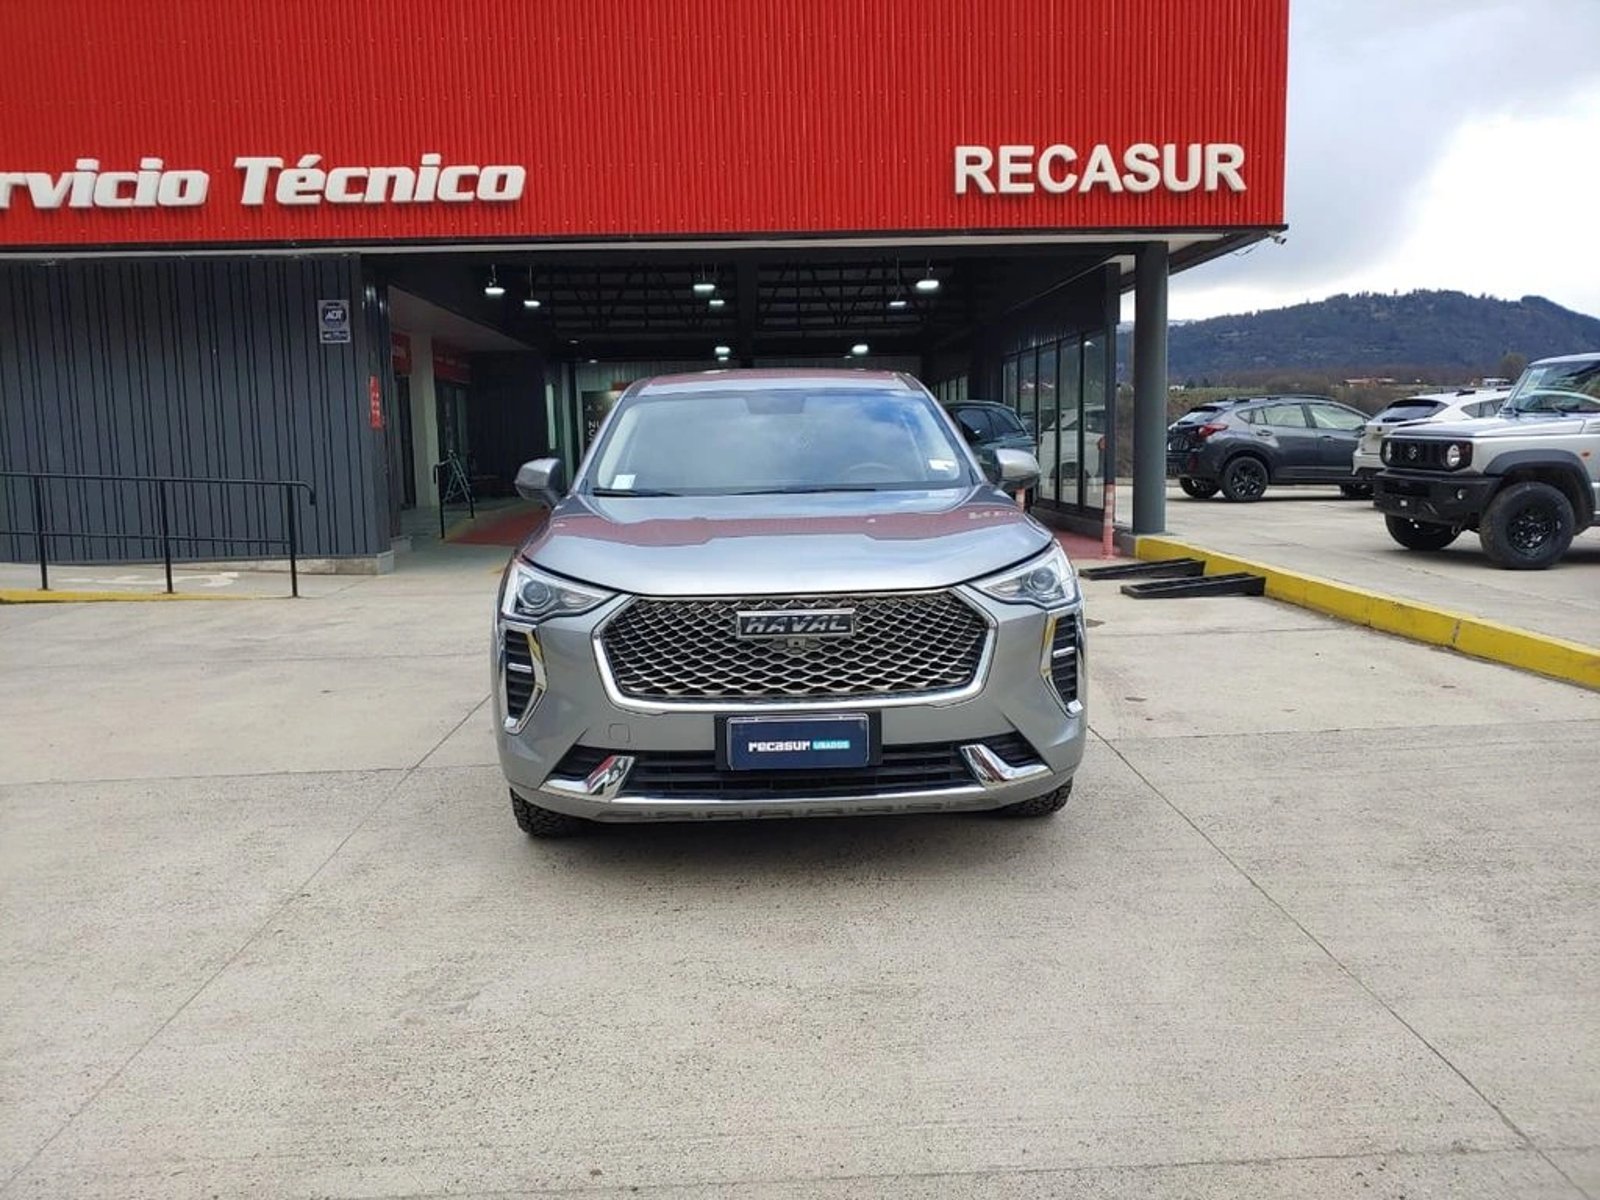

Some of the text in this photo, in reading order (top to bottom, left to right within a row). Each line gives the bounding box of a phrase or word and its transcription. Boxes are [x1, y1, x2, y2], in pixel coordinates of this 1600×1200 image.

[954, 143, 1247, 195] RECASUR
[234, 153, 526, 205] Técnico
[324, 310, 343, 320] ADT
[746, 615, 848, 633] HAVAL
[748, 740, 811, 752] recasur
